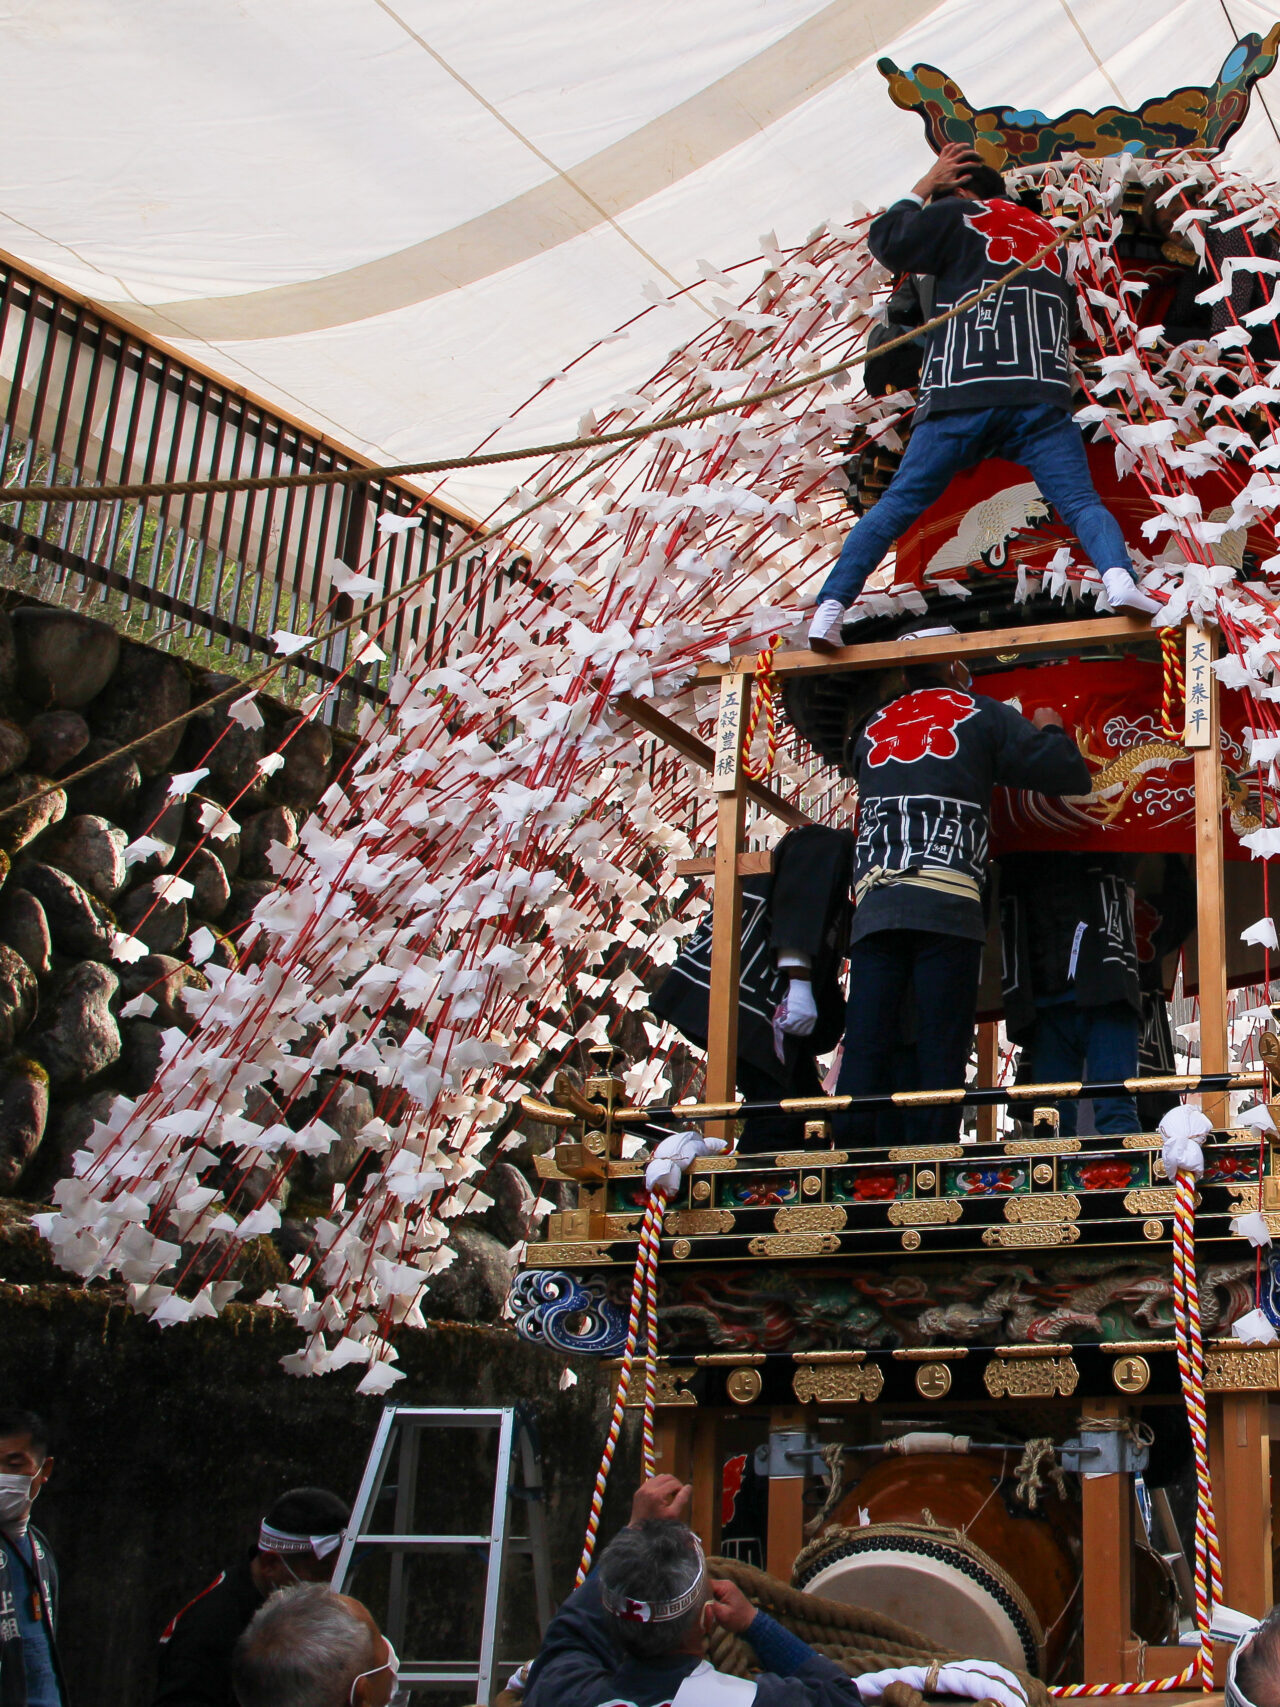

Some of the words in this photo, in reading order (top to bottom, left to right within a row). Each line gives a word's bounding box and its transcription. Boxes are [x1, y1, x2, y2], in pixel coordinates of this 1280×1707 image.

[962, 197, 1064, 278] 祭
[864, 687, 982, 769] 祭
[1187, 642, 1210, 735] 天下泰平
[931, 824, 954, 856] 上組
[0, 1590, 21, 1641] 上組
